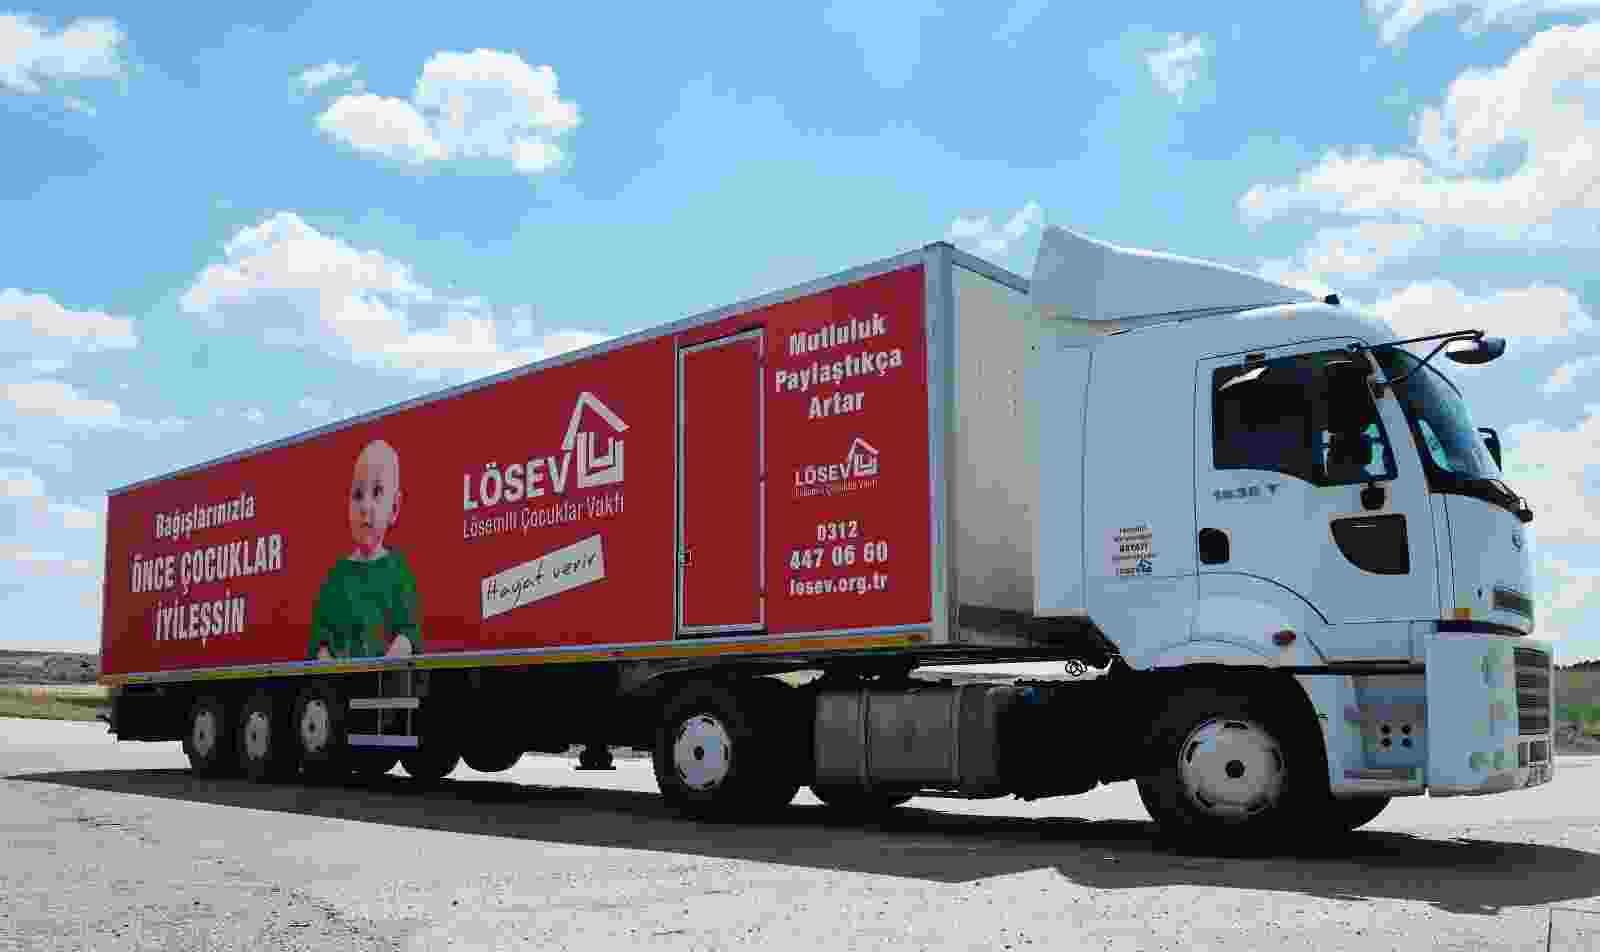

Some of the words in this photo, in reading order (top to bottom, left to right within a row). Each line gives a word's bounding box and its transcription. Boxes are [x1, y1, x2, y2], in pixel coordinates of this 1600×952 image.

[789, 314, 886, 356] Mutluluk
[775, 348, 903, 392] Paylaştıkça
[808, 391, 865, 419] Artar
[463, 453, 572, 511] LÖSEV
[794, 462, 849, 487] LÖSEV
[520, 502, 584, 535] Çocuklar
[586, 491, 625, 517] Vakfı
[816, 519, 859, 542] 0312
[129, 551, 176, 593] ÖNCE
[179, 533, 282, 595] ÇOCUKLAR
[789, 548, 825, 570] 447
[831, 545, 857, 566] 06
[487, 559, 545, 608] Hayat
[551, 552, 599, 580] verir
[789, 571, 888, 597] losev.org.tr
[155, 588, 246, 648] İYİLEŞSİN
